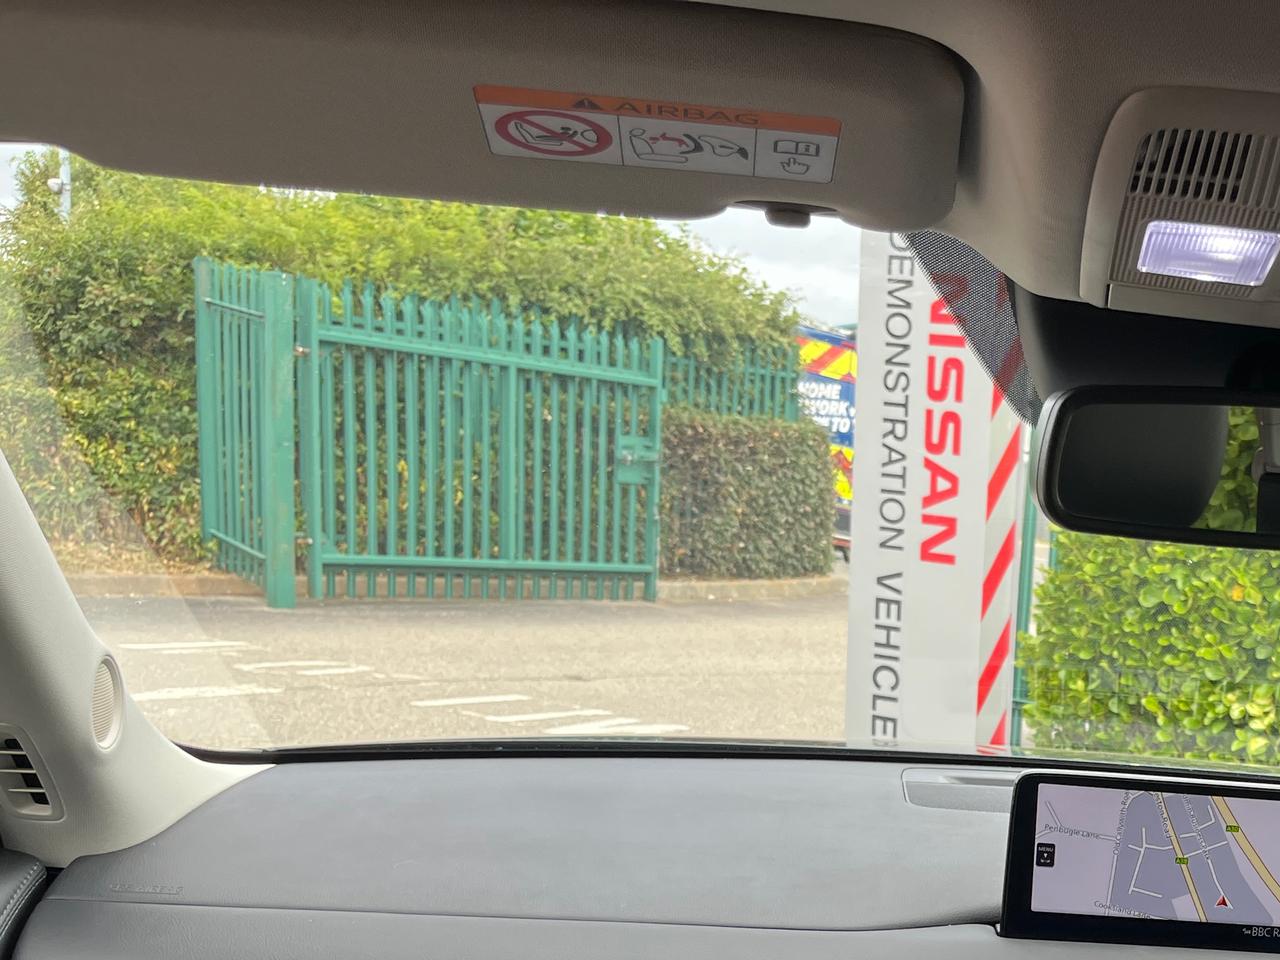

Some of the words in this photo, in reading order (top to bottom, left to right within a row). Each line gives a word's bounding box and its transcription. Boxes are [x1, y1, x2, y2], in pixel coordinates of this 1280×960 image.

[615, 102, 761, 126] AIRBAG
[919, 272, 970, 566] NISSAN
[871, 572, 903, 740] VEHICLE
[1160, 816, 1173, 839] Road
[1252, 927, 1271, 938] BBC
